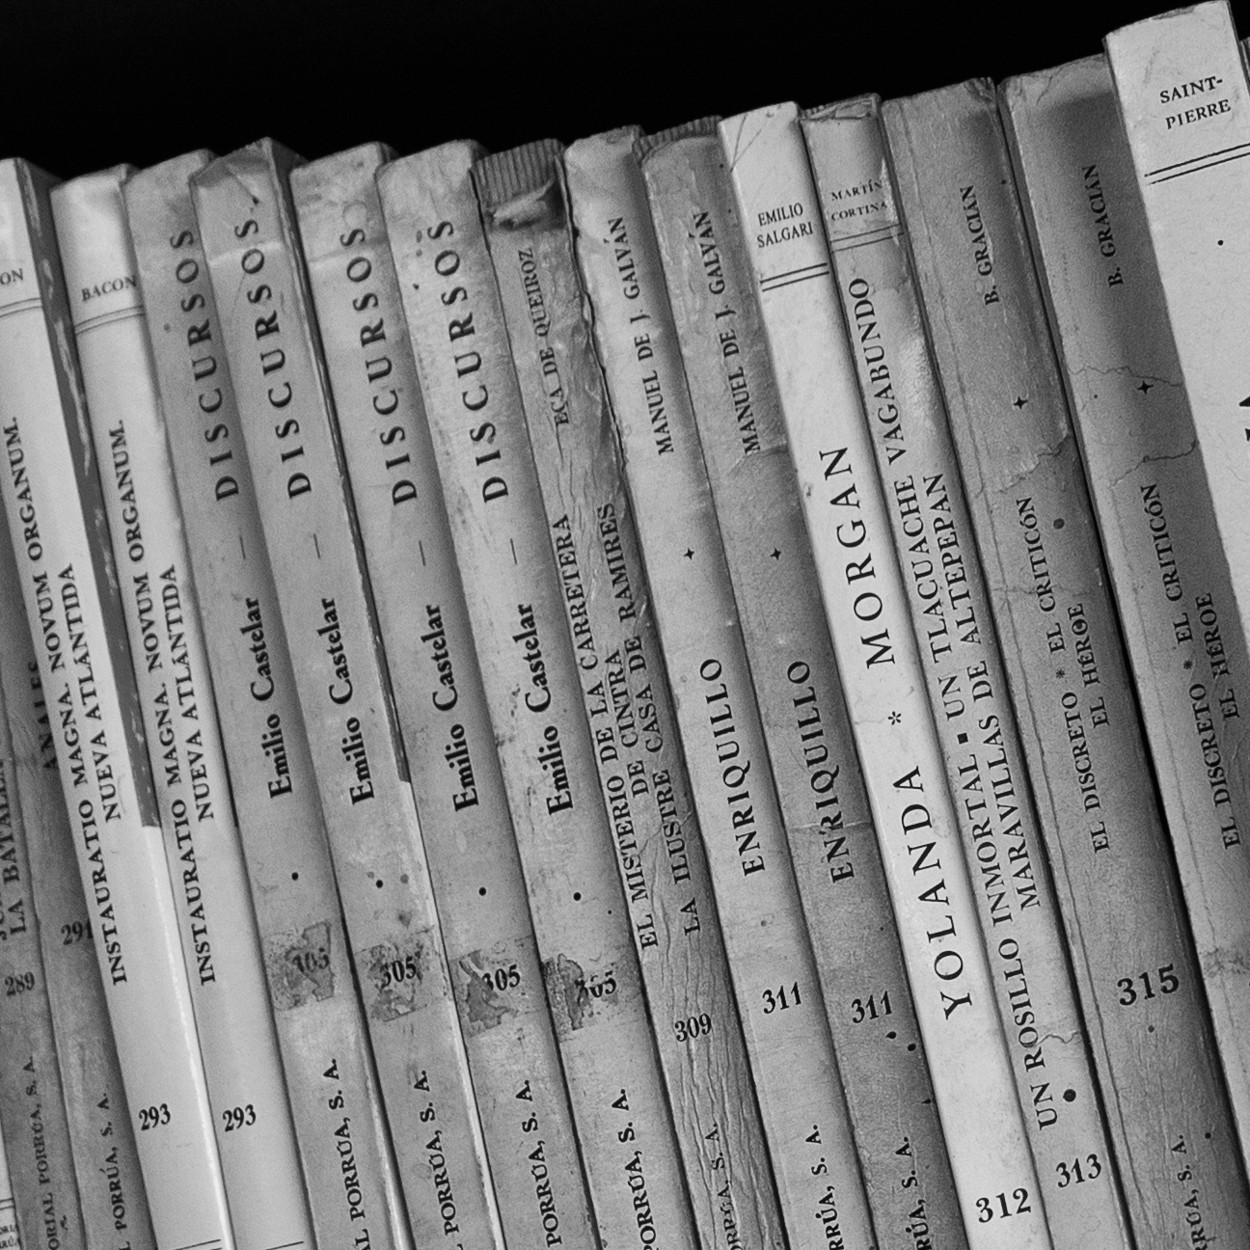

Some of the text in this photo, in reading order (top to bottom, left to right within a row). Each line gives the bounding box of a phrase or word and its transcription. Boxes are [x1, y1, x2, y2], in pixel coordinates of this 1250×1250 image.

[1160, 76, 1223, 104] SAINT-
[1166, 99, 1231, 129] PIERRE
[757, 224, 813, 249] SALGARI
[758, 203, 804, 226] EMILIO
[603, 217, 645, 301] GALVÁN
[984, 287, 999, 305] B.
[634, 332, 653, 361] DE
[642, 369, 674, 455] MANUEL
[3, 416, 42, 561] ORGANUM.
[33, 573, 65, 673] NOVUM
[108, 420, 215, 983] INSTAURATIO MAGNA. NOVUM ORGANUM.
[241, 598, 293, 799] Emilio Castelar
[420, 604, 480, 811] Emilio Castelar
[513, 602, 575, 814] Emilio Castelar
[818, 446, 972, 1020] YOLANDA MORGAN
[848, 278, 1058, 1130] UN ROSILLO INMORTAL UN TLACUACHE VAGABUNDO
[922, 474, 1040, 909] MARAVILLAS DE ALTEPEPAN
[59, 681, 88, 788] MAGNA.
[89, 730, 121, 822] NUEVA
[186, 730, 215, 820] NUEVA
[700, 658, 766, 877] ENRIQUILLO
[787, 661, 855, 882] ENRIQUILLO
[78, 799, 127, 984] INSTAURATIO
[675, 1013, 712, 1043] 309
[762, 983, 802, 1014] 311
[852, 993, 894, 1024] 311
[1118, 965, 1180, 1006] 315
[138, 1104, 171, 1130] 293
[223, 1105, 256, 1131] 293
[330, 1089, 345, 1111] S.
[976, 1188, 1032, 1223] 312
[1056, 1156, 1102, 1188] 313
